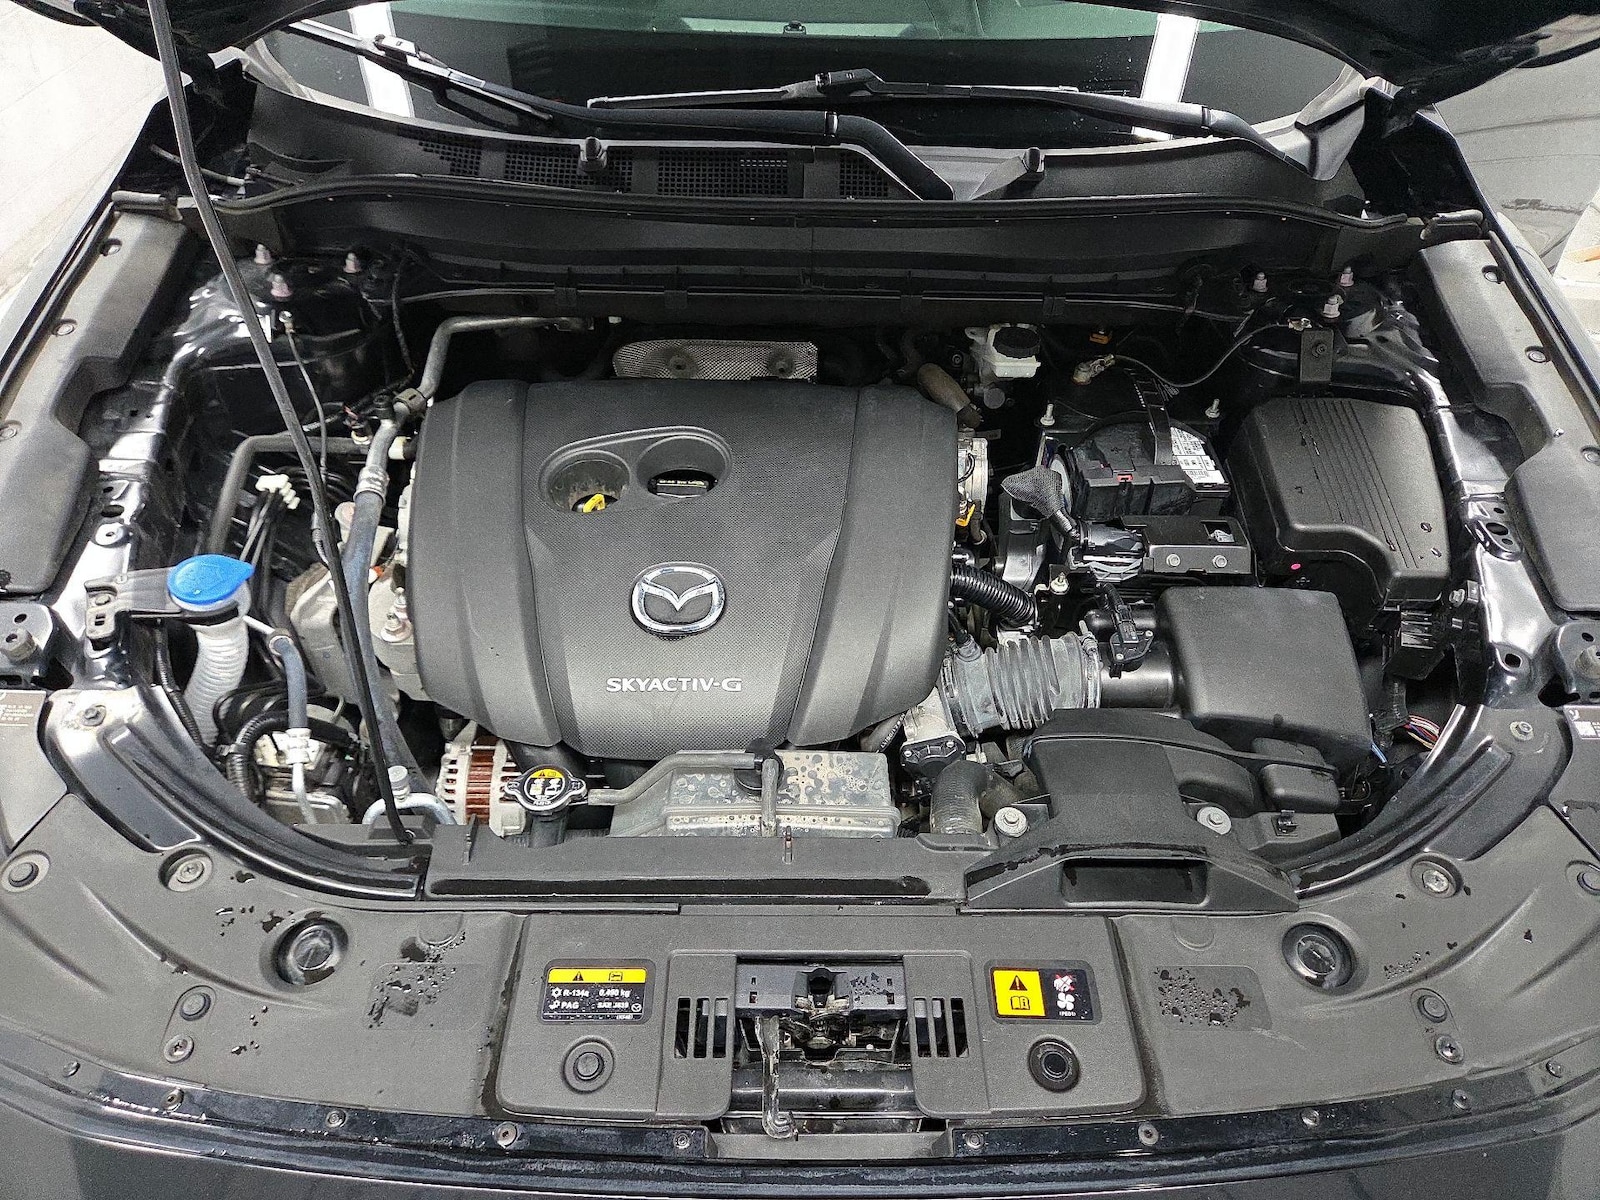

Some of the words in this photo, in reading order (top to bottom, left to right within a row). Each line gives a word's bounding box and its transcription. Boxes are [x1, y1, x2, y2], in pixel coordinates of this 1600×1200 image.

[606, 677, 742, 692] SKYACTIV-G
[563, 989, 590, 998] R-134a
[620, 988, 631, 998] kg
[561, 1001, 579, 1009] PAG
